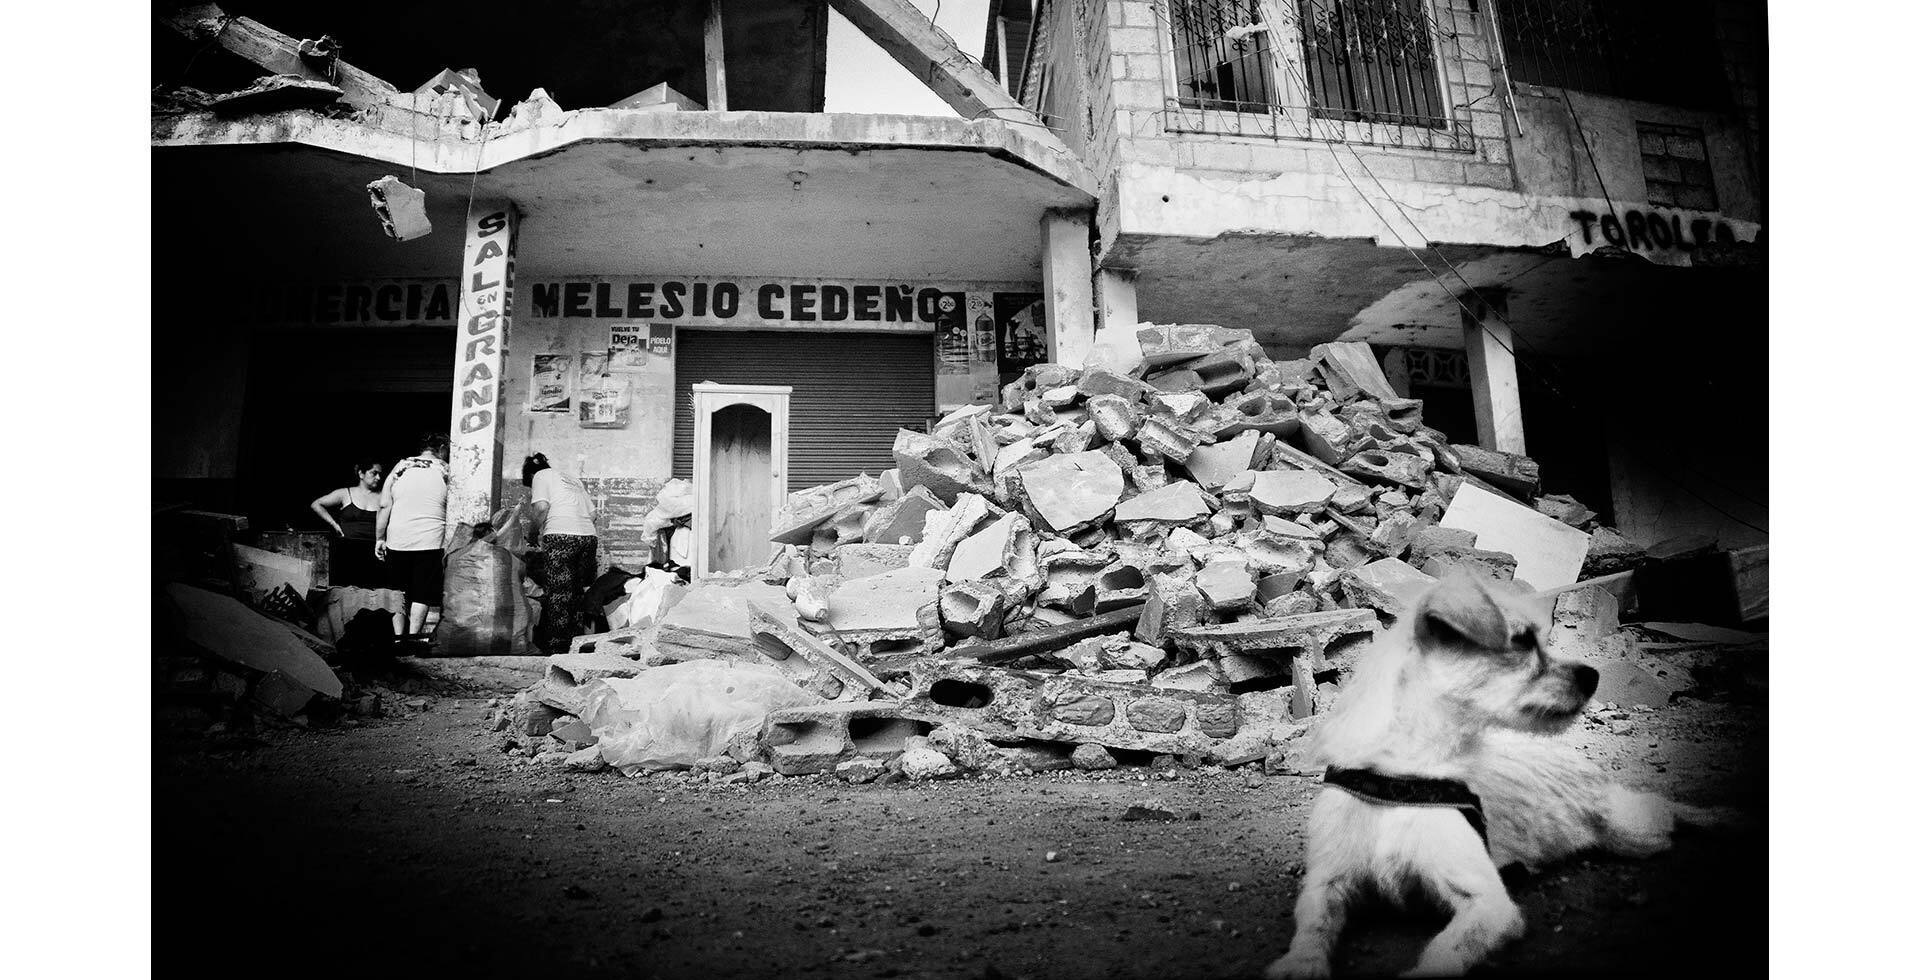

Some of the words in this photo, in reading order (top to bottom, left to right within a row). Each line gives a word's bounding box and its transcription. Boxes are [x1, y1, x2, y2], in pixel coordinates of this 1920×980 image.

[472, 212, 506, 292] SAL
[531, 281, 740, 319] MELESIO
[757, 283, 944, 323] CEDEÑO
[612, 334, 638, 346] Deja
[459, 309, 498, 434] GRANO
